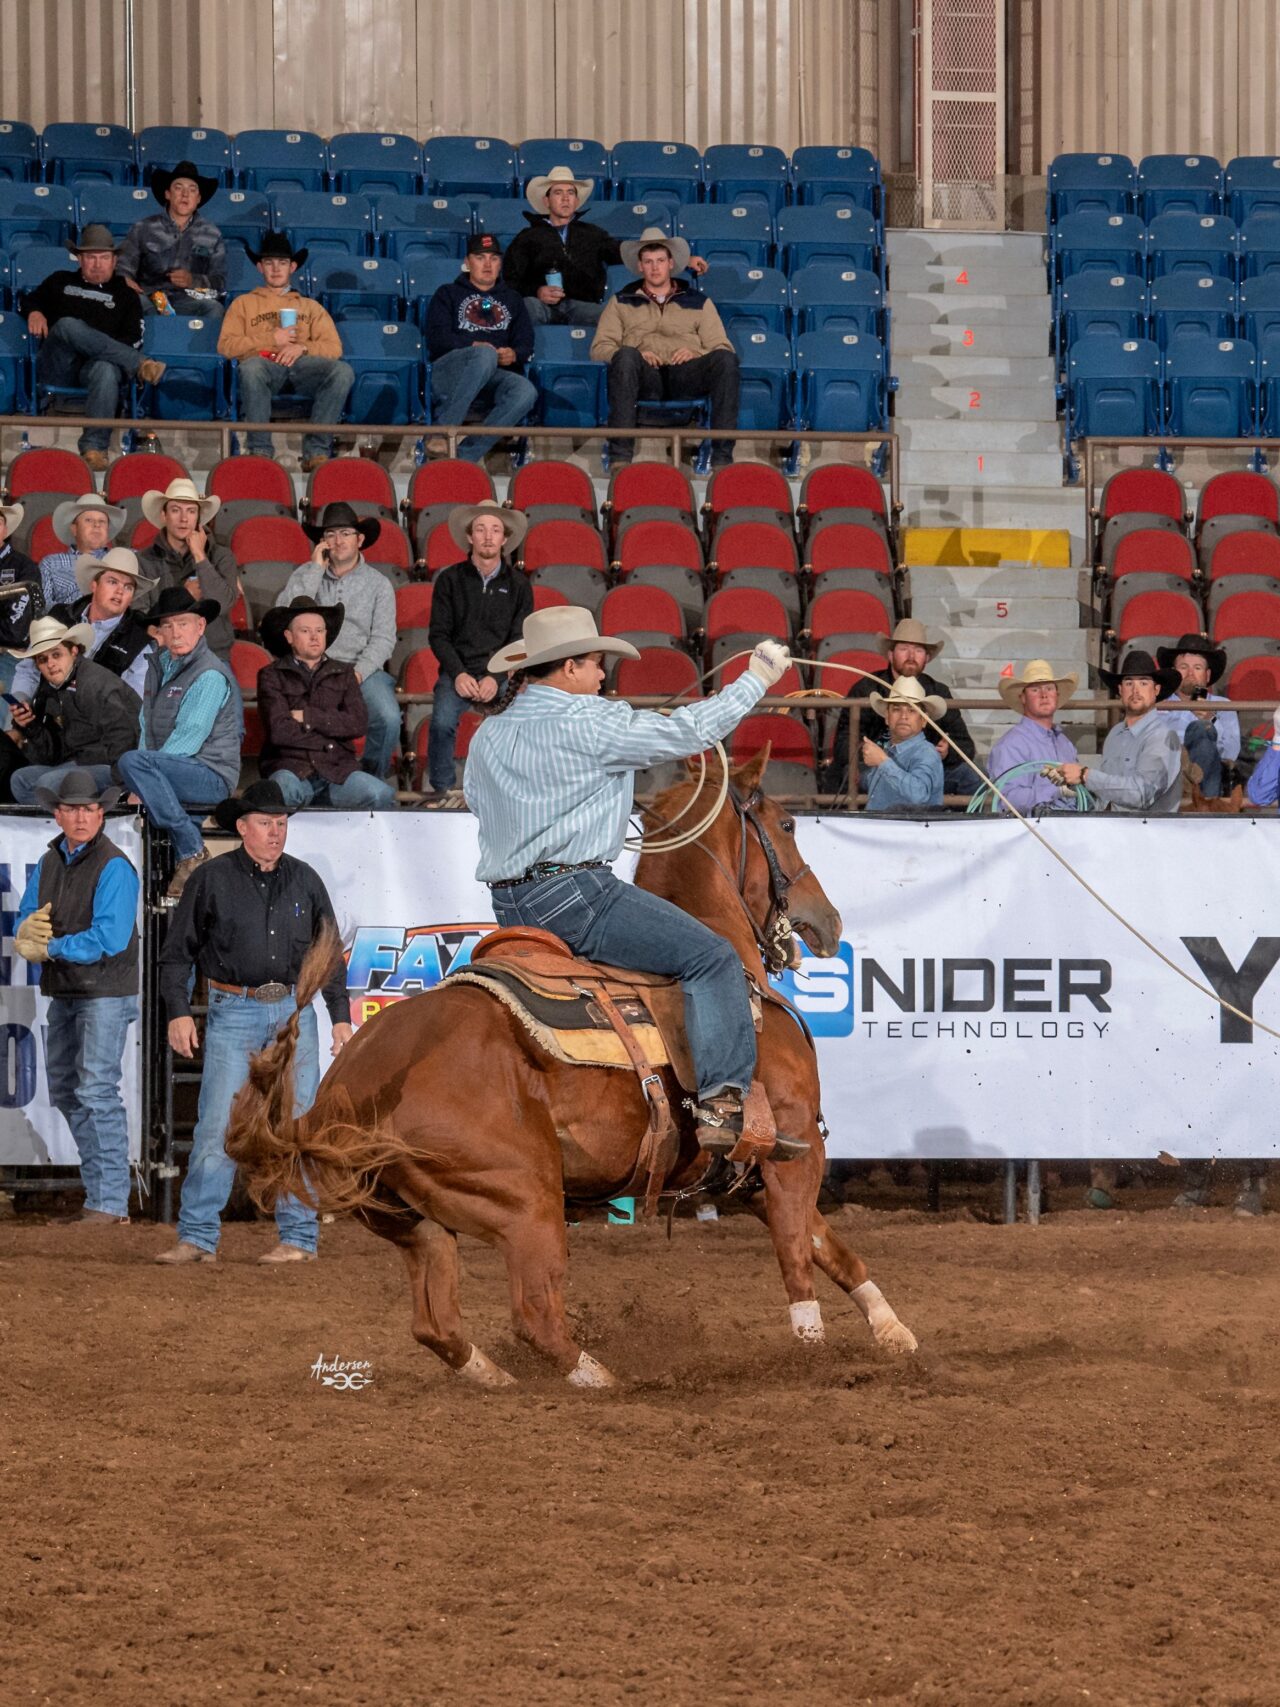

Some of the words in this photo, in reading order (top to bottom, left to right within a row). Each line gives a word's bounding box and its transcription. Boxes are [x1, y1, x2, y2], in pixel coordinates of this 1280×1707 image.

[956, 271, 969, 285] 4
[962, 330, 975, 346] 3
[969, 392, 982, 408] 2
[977, 455, 985, 473] 1
[996, 602, 1008, 619] 5
[863, 1020, 1110, 1039] TECHNOLOGY
